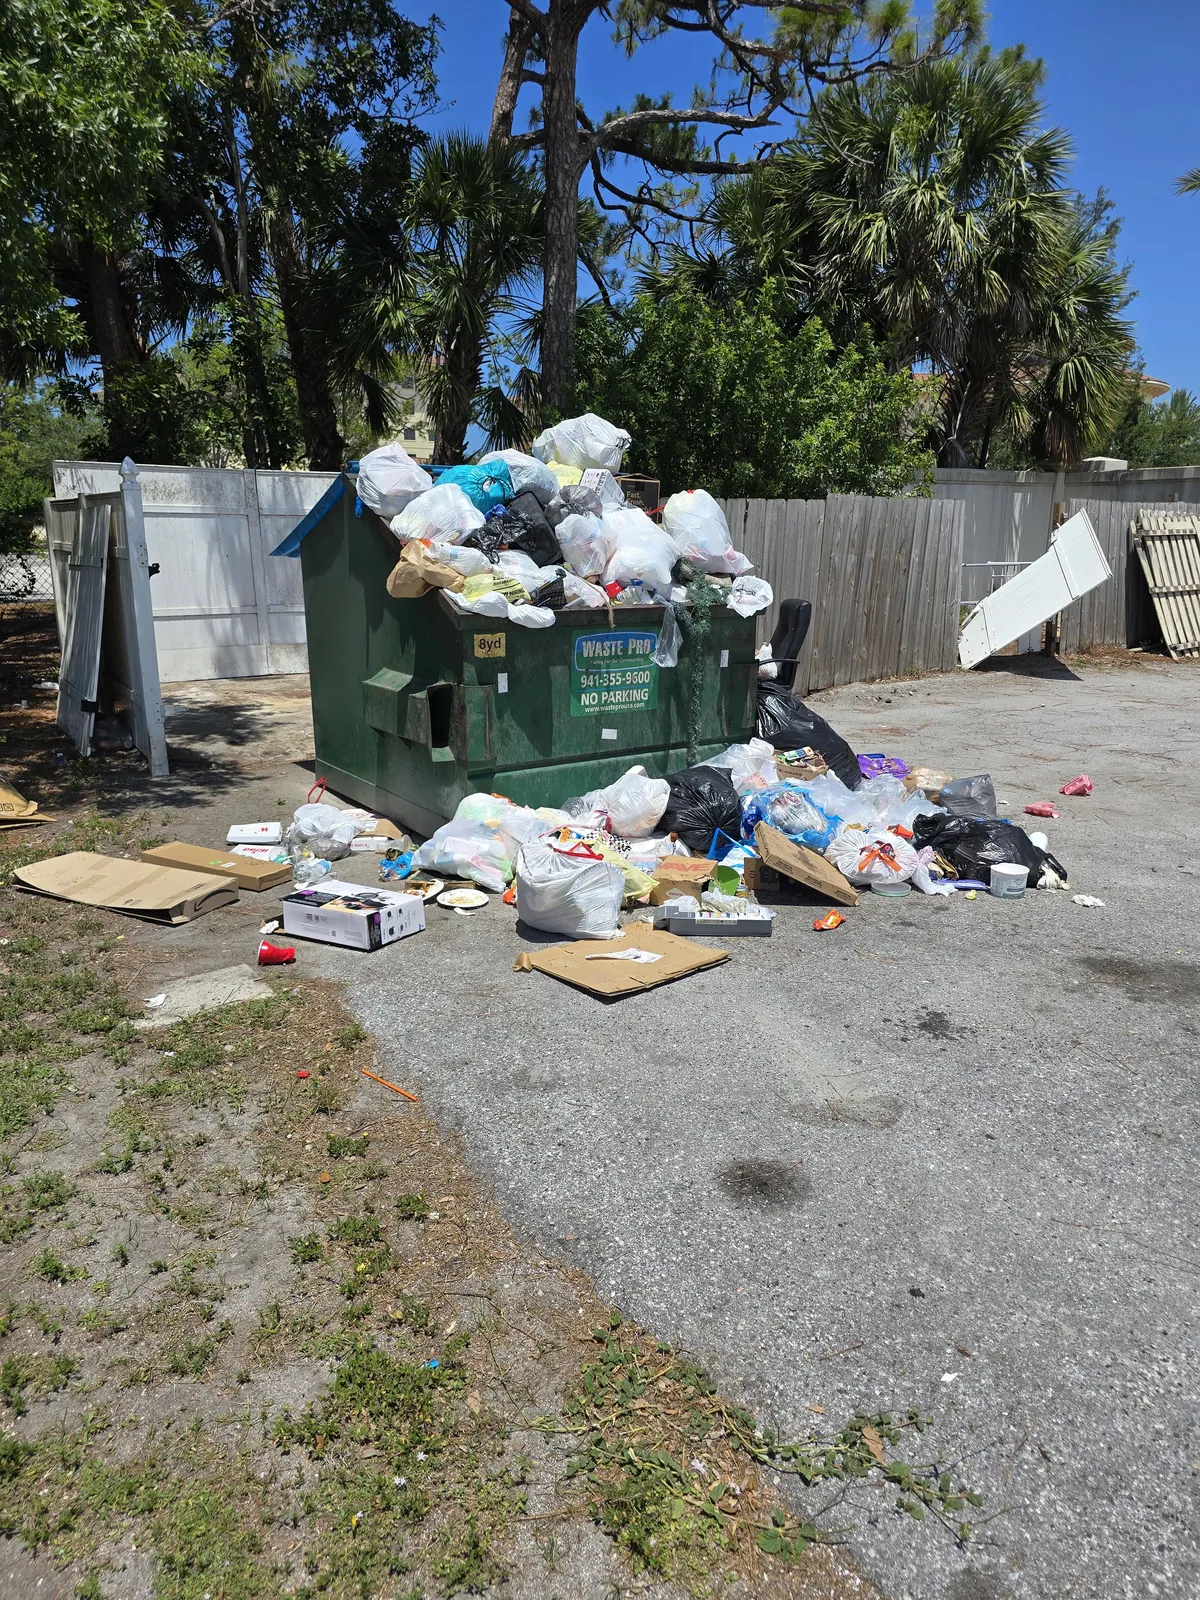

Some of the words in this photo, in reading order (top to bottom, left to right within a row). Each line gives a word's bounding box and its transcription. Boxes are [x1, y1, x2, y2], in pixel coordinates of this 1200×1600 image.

[479, 638, 501, 652] 8yd
[582, 640, 623, 658] WASTE
[628, 638, 651, 655] PRO
[581, 671, 650, 688] 941-355-9600
[581, 692, 598, 706] NO
[601, 688, 649, 704] PARKING
[585, 702, 645, 713] www.wasteprousa.com
